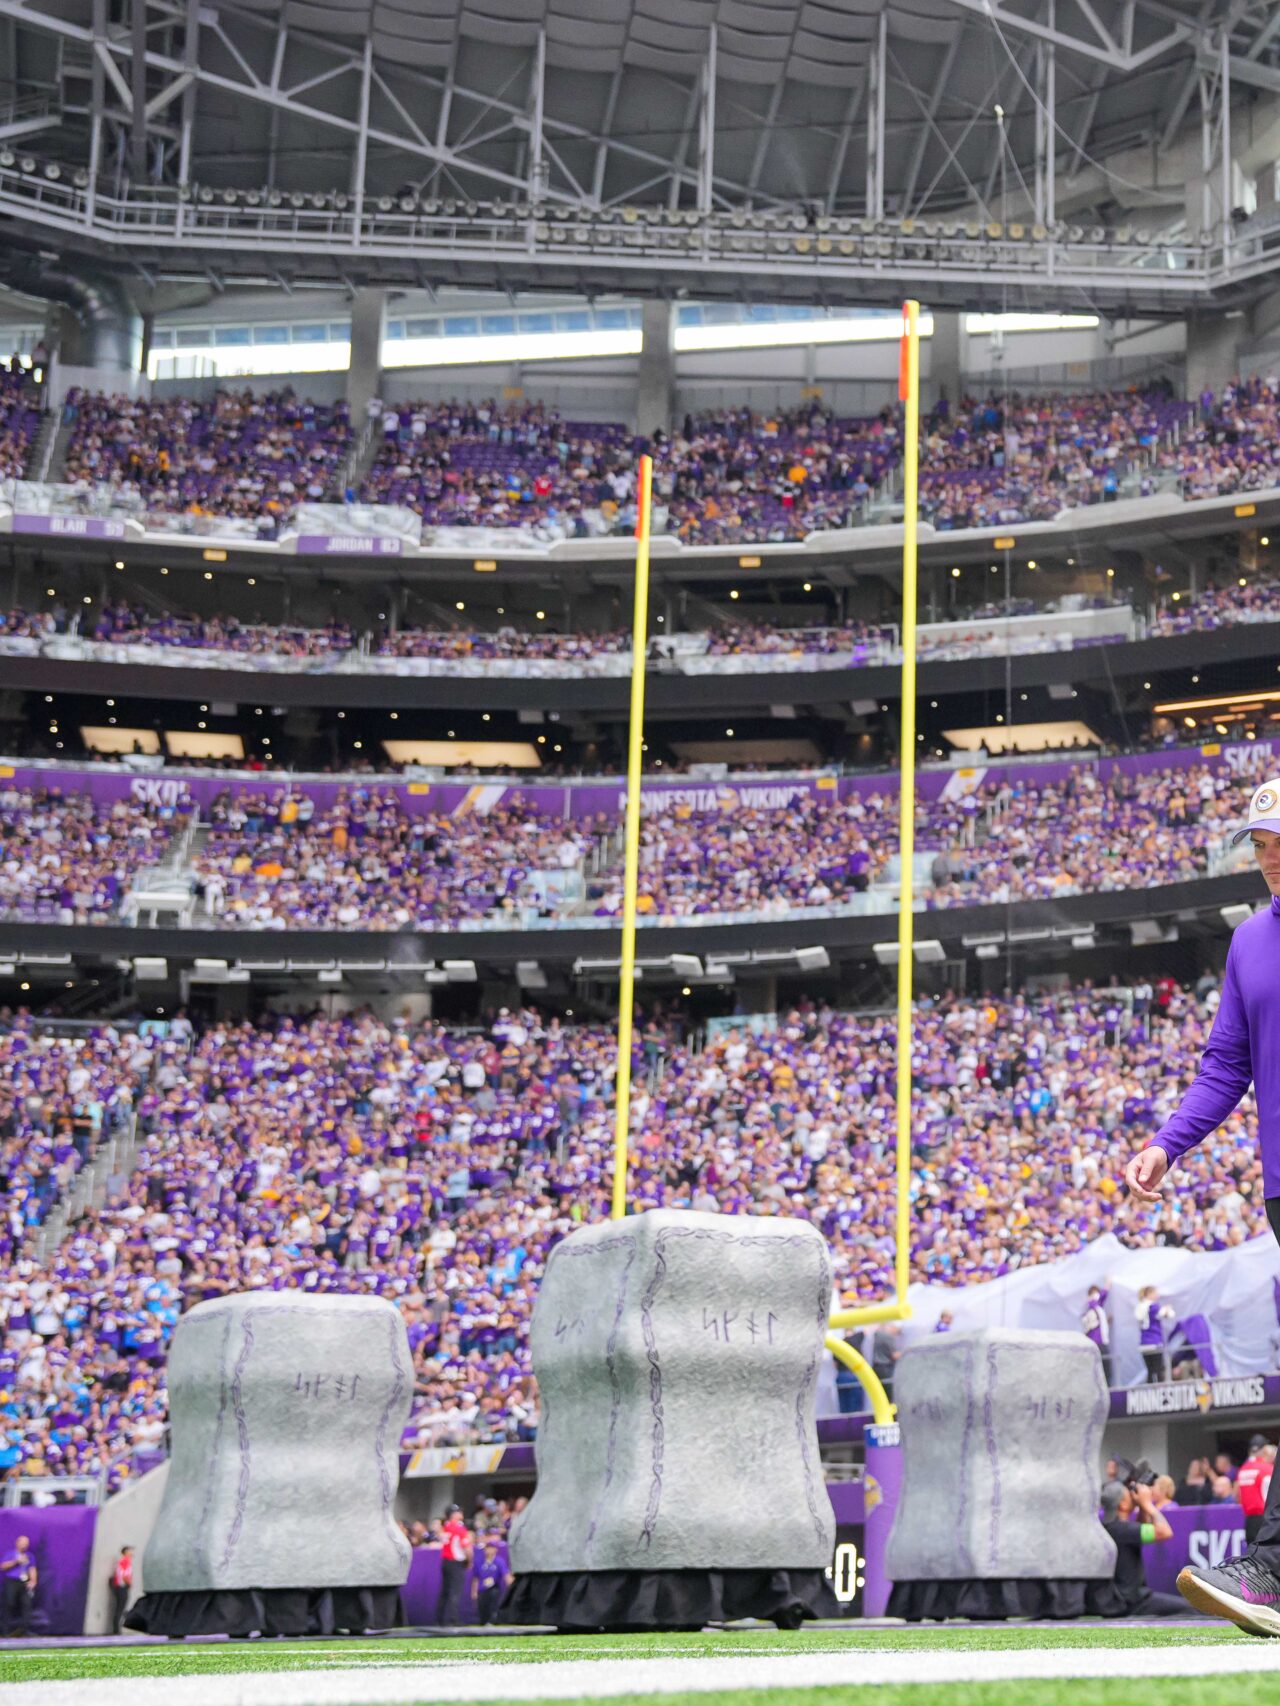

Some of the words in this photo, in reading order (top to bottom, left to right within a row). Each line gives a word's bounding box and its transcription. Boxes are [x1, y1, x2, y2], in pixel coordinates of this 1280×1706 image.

[327, 537, 373, 552] JORDAN
[1127, 1385, 1198, 1415] MINNESOTA
[1213, 1376, 1265, 1407] VIKINGS
